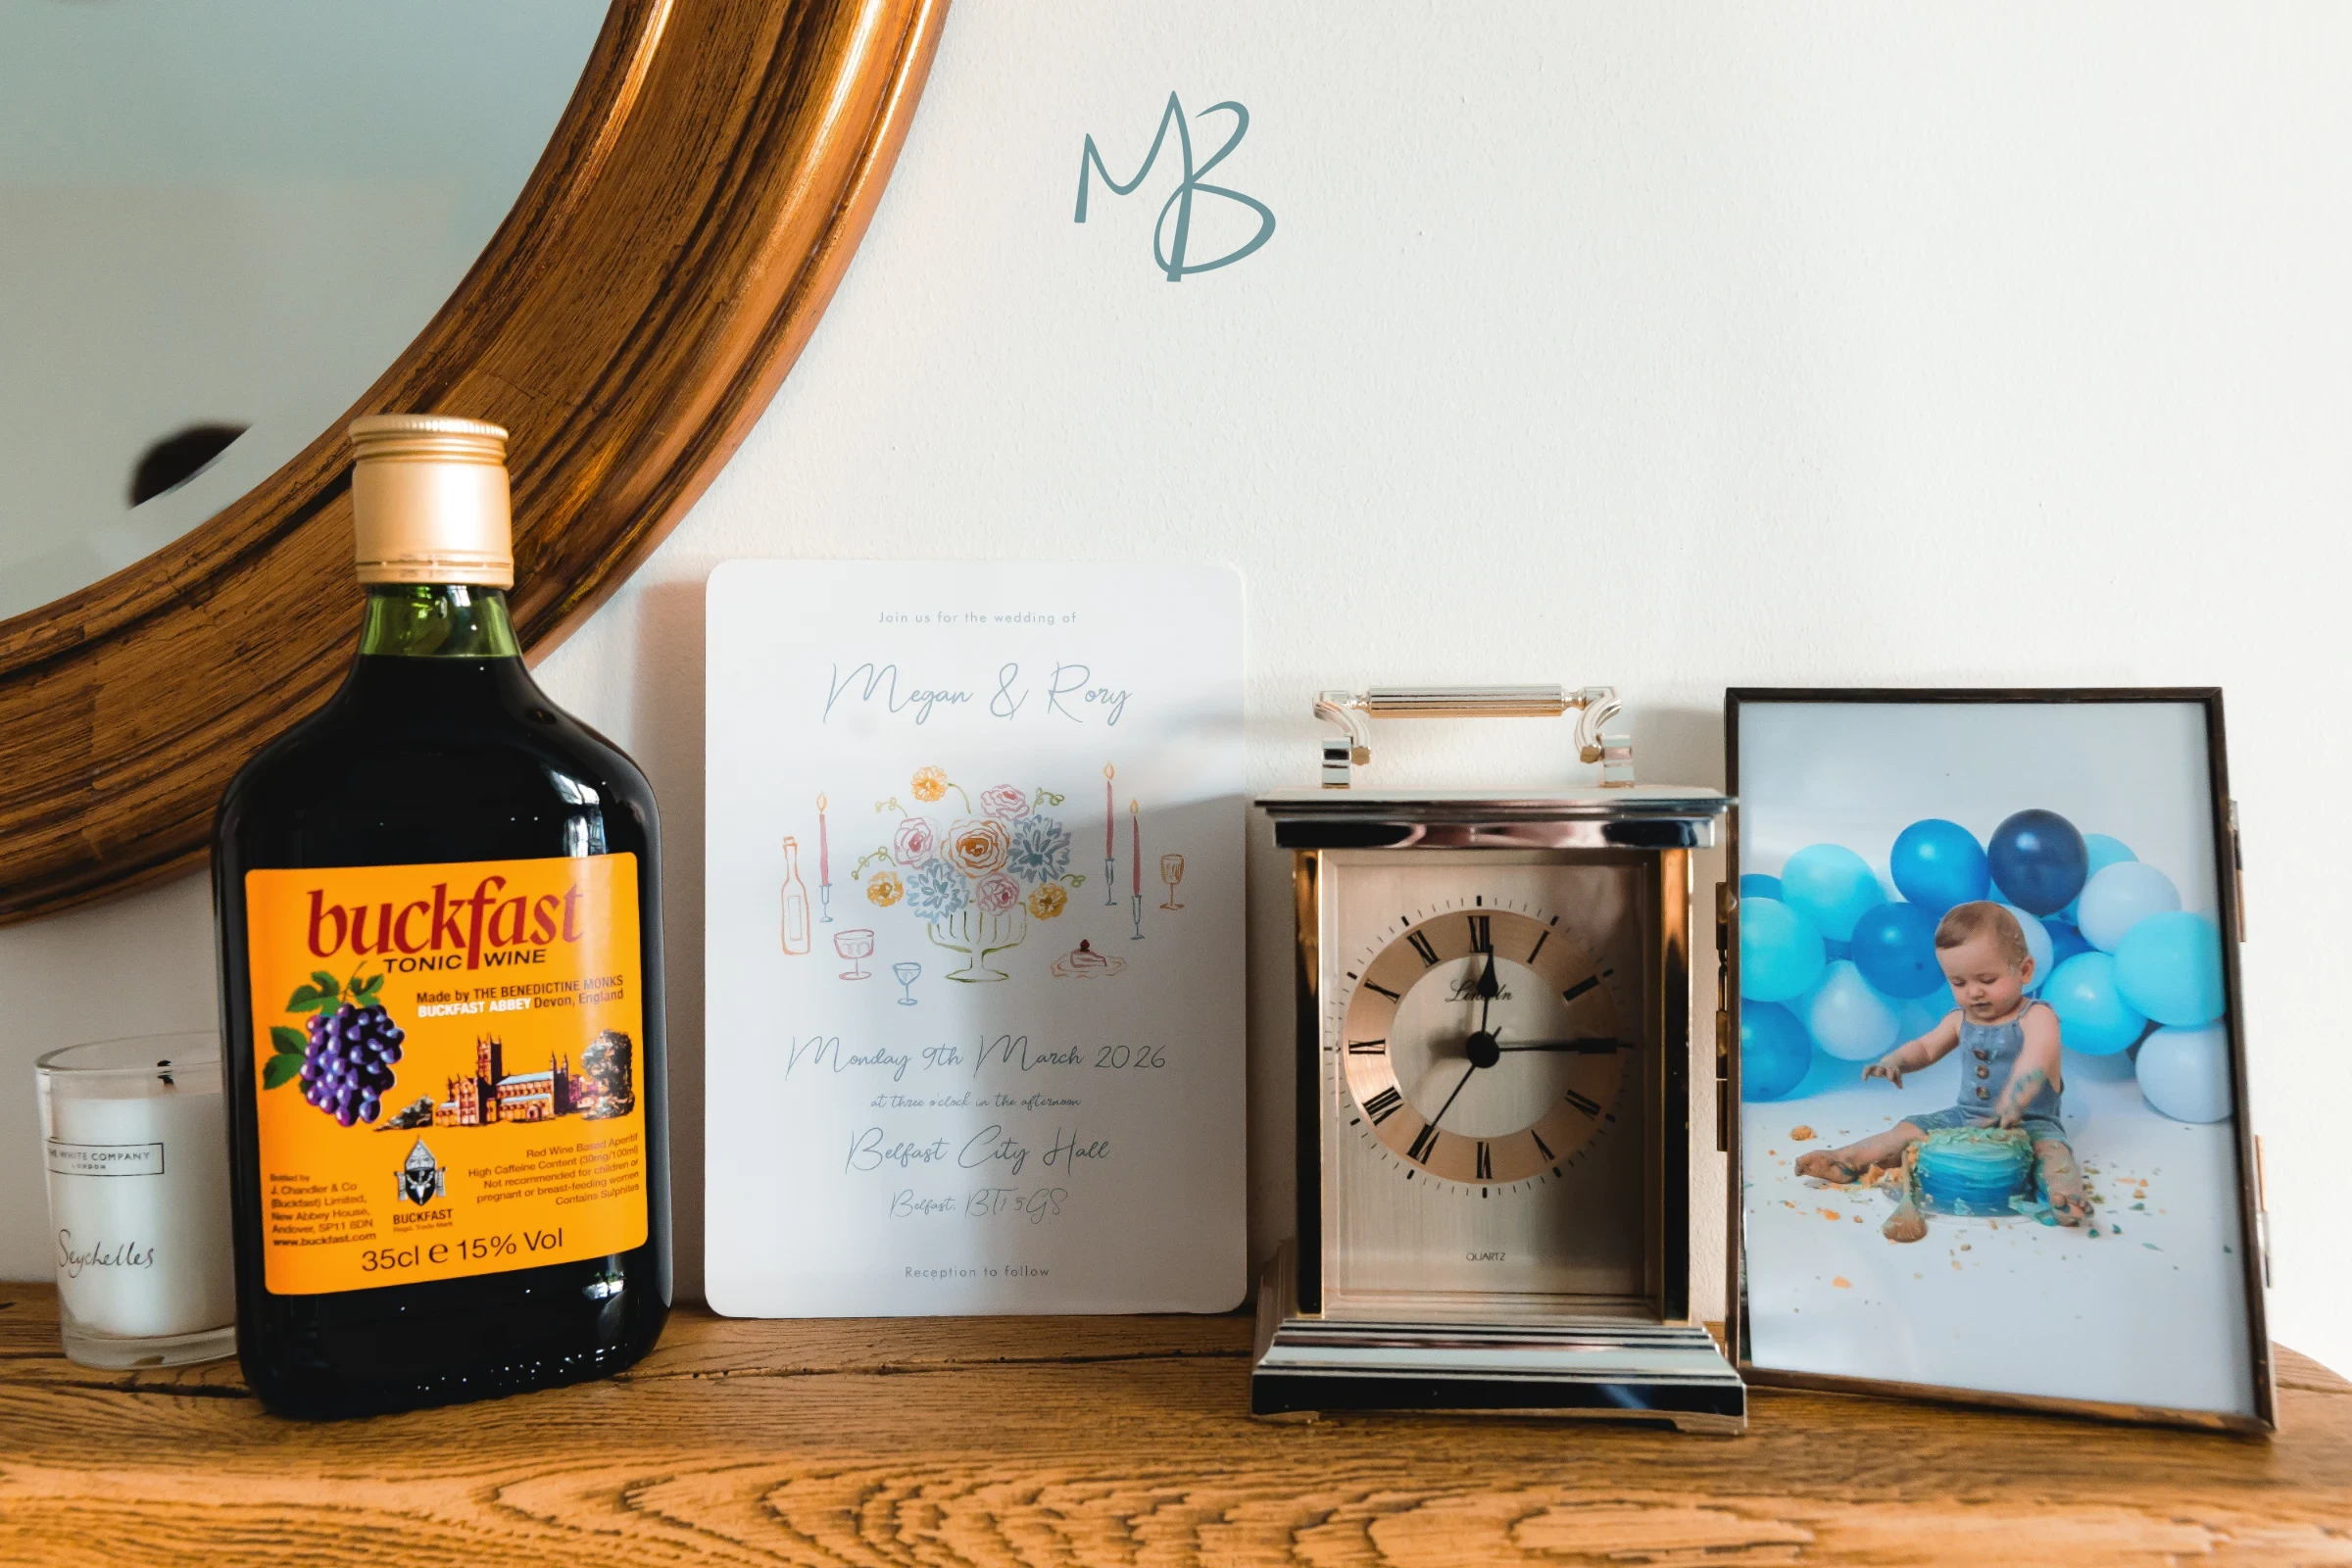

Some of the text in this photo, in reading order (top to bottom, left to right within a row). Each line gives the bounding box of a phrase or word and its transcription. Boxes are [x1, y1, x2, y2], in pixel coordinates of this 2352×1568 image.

[878, 611, 1077, 626] Join us for the wedding of
[822, 661, 1133, 726] Megan & Rory
[307, 875, 584, 970] buckfast
[384, 949, 546, 974] TONIC WINE
[416, 975, 623, 1004] Made by THE BENEDICTINE MONKS
[417, 989, 623, 1018] BUCKFAST ABBEY Devon, England
[785, 1034, 1166, 1082] Monday 9th March 2026
[870, 1092, 1082, 1111] at three o'clock in the afternoon
[59, 1151, 88, 1160] WHITE
[90, 1152, 151, 1161] COMPANY
[526, 1133, 638, 1158] Red Wine Based Aperitif
[845, 1124, 1111, 1176] Belfast City Hall
[467, 1168, 491, 1179] High
[494, 1164, 536, 1175] Caffeine
[538, 1158, 577, 1170] Content
[483, 1158, 639, 1190] Not recommended for children or
[331, 1183, 338, 1193] &
[341, 1181, 358, 1192] Co
[476, 1171, 639, 1204] pregnant or breast-feeding women
[556, 1183, 639, 1205] Contains Sulphites
[295, 1211, 329, 1222] Abbey
[393, 1208, 454, 1225] BUCKFAST
[273, 1232, 376, 1247] www.buckfast.com
[362, 1246, 419, 1272] 35cl
[457, 1234, 517, 1260] 15%
[523, 1227, 564, 1251] Vol
[58, 1229, 154, 1278] Seychelles
[1466, 1252, 1506, 1262] QUARTZ
[905, 1265, 1050, 1281] Reception to follow
